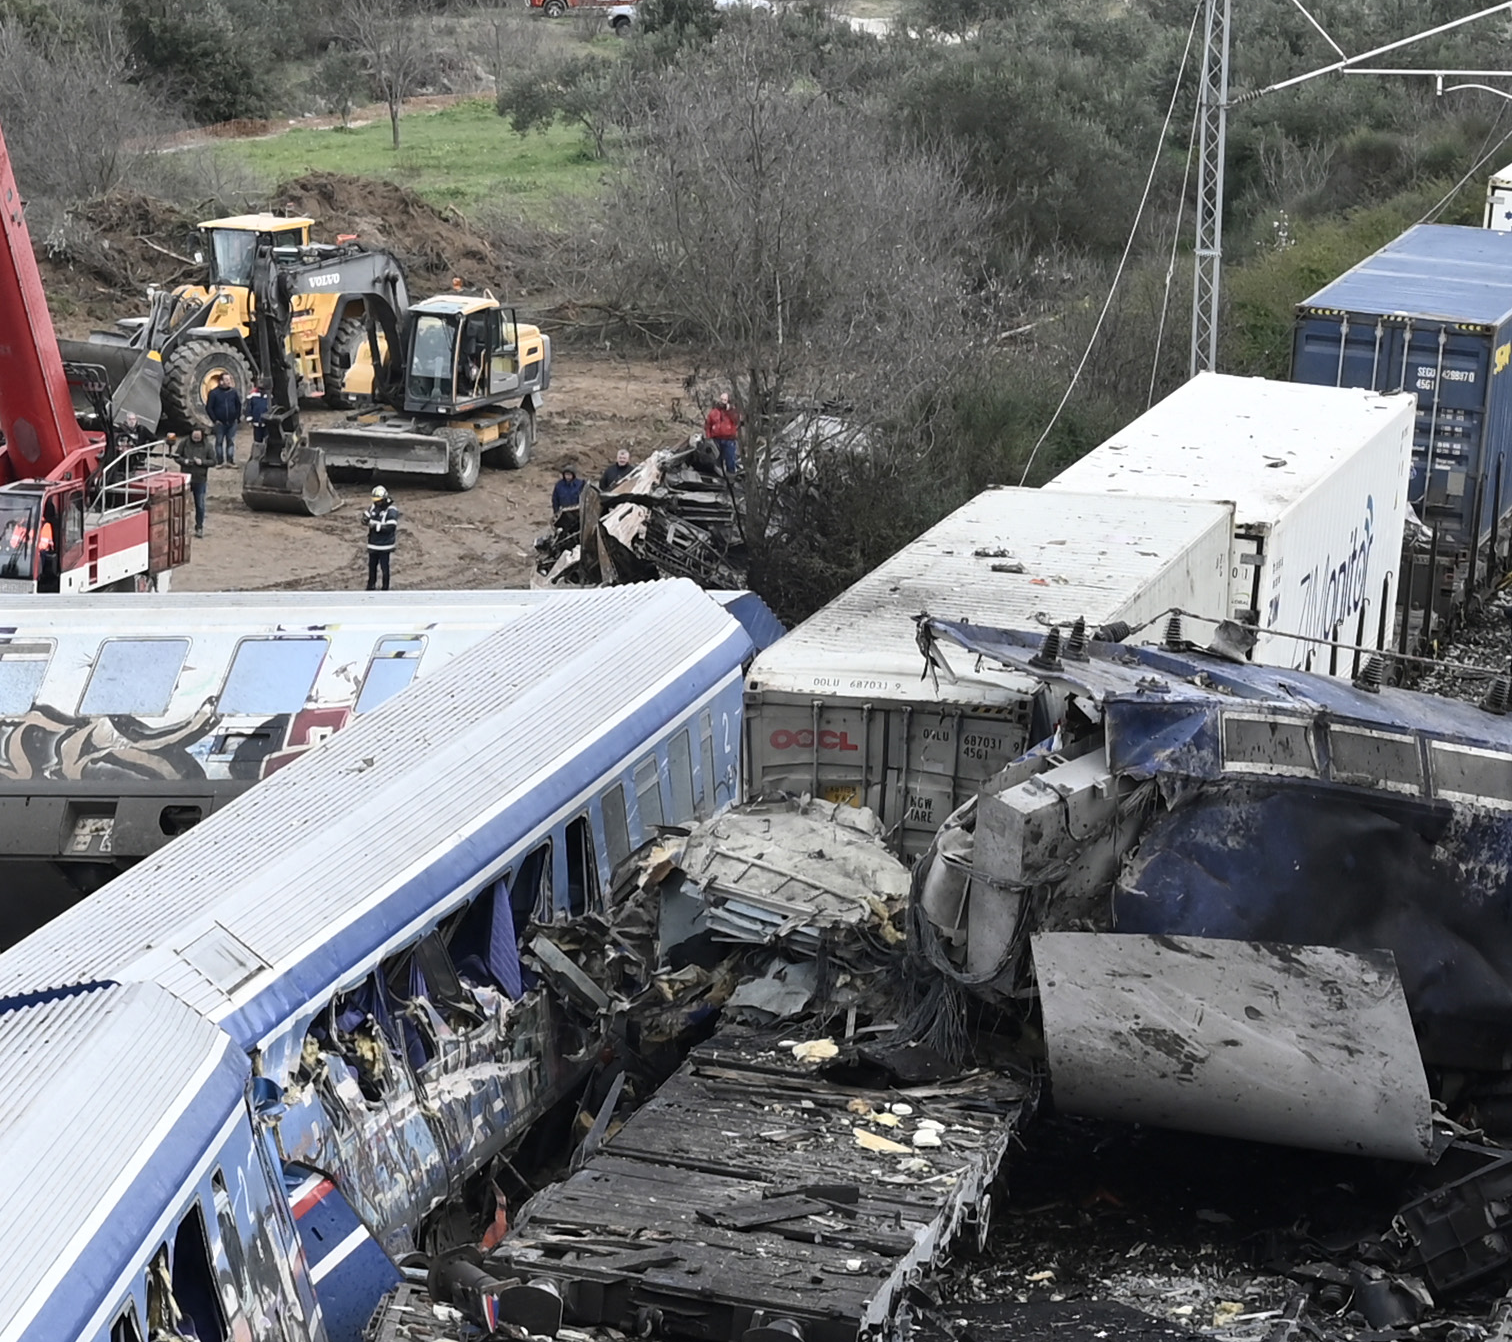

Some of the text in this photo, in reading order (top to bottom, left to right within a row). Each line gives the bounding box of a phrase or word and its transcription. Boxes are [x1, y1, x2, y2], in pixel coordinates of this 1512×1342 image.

[308, 272, 341, 289] VOLVO
[813, 677, 840, 687] OOLU
[849, 679, 889, 690] 687031
[722, 712, 732, 754] 2
[769, 729, 858, 751] OOCL
[922, 728, 1020, 754] OOLU 687031 9
[963, 746, 989, 760] 45G1
[910, 808, 933, 824] TARE
